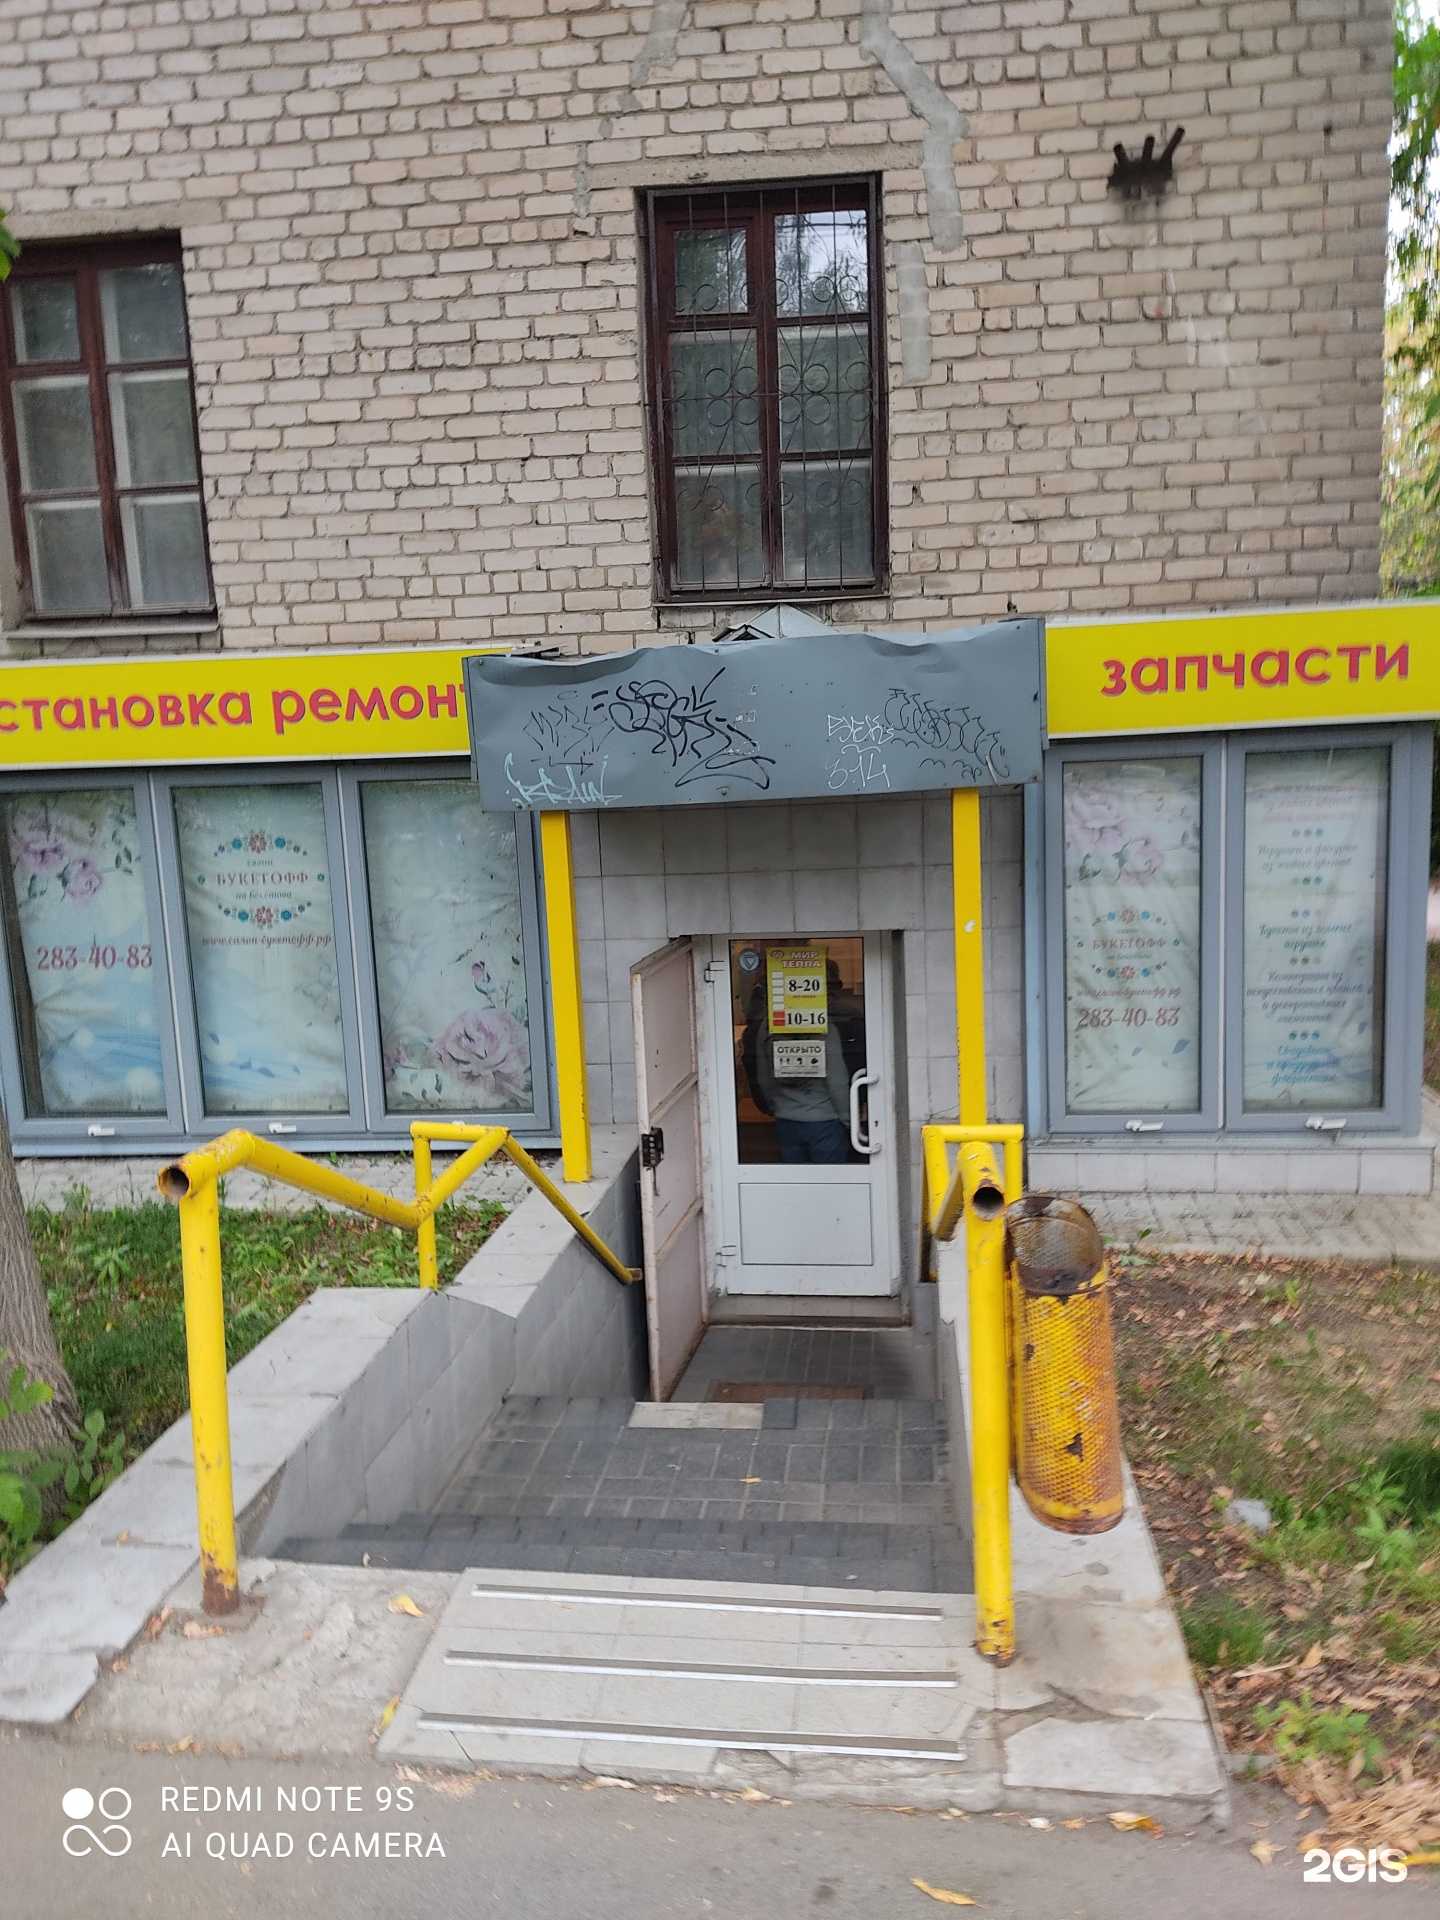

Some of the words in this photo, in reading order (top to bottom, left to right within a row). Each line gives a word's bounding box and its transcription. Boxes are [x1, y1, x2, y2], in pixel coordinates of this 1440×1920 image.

[1100, 642, 1410, 697] запчасти
[271, 682, 465, 736] ремон
[216, 870, 309, 887] БУКЕТОФФ
[36, 944, 153, 971] 283-40-83
[788, 979, 821, 993] 8-20
[786, 1012, 826, 1026] 10-16
[1075, 1007, 1181, 1031] 283-40-83
[776, 1046, 822, 1055] ОТКРЫТО
